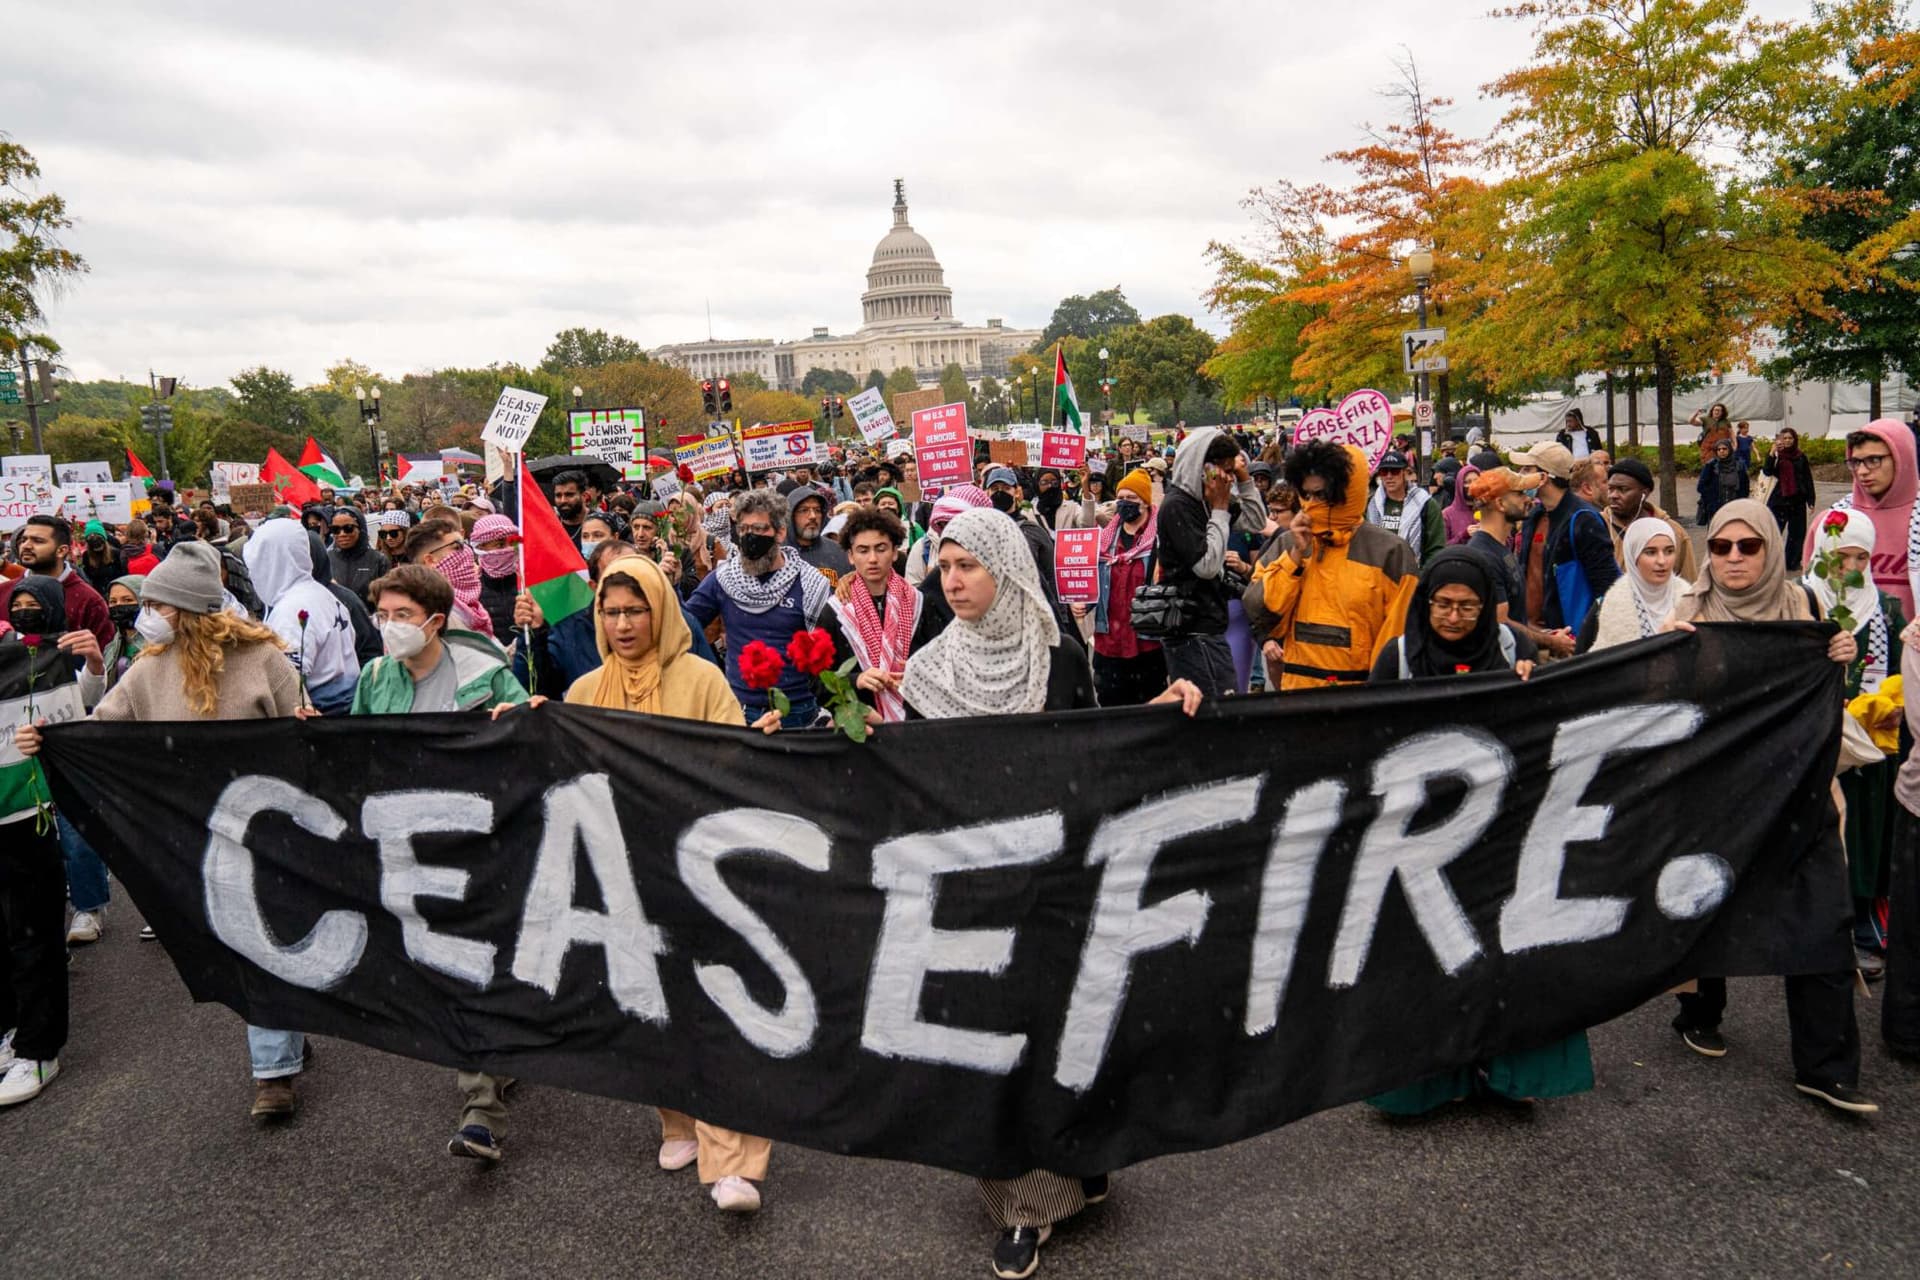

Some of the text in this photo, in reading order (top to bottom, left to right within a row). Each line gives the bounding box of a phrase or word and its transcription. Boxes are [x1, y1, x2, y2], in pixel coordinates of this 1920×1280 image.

[499, 395, 541, 414] CEASE
[495, 408, 529, 426] FIRE
[922, 408, 957, 421] NO U.S. AID
[1297, 395, 1382, 443] CEASEFIRE
[589, 424, 627, 436] JEWISH
[934, 421, 946, 430] FOR
[495, 424, 527, 440] NOW
[926, 432, 957, 444] GENOCIDE
[584, 436, 633, 448] SOLIDARITY
[1051, 436, 1058, 444] NO
[1070, 438, 1079, 446] AID
[677, 449, 695, 460] State
[697, 446, 704, 454] of
[750, 446, 768, 455] State
[751, 452, 777, 461] "Israel"
[922, 448, 964, 461] END THE SIEGE
[1059, 447, 1069, 455] FOR
[751, 456, 813, 470] And its Atrocities
[932, 461, 957, 471] ON GAZA
[659, 482, 678, 497] CEASE
[1083, 533, 1092, 541] AID
[1072, 545, 1082, 553] FOR
[1064, 556, 1088, 564] GENOCIDE
[203, 700, 1735, 1095] CEASEFIRE.
